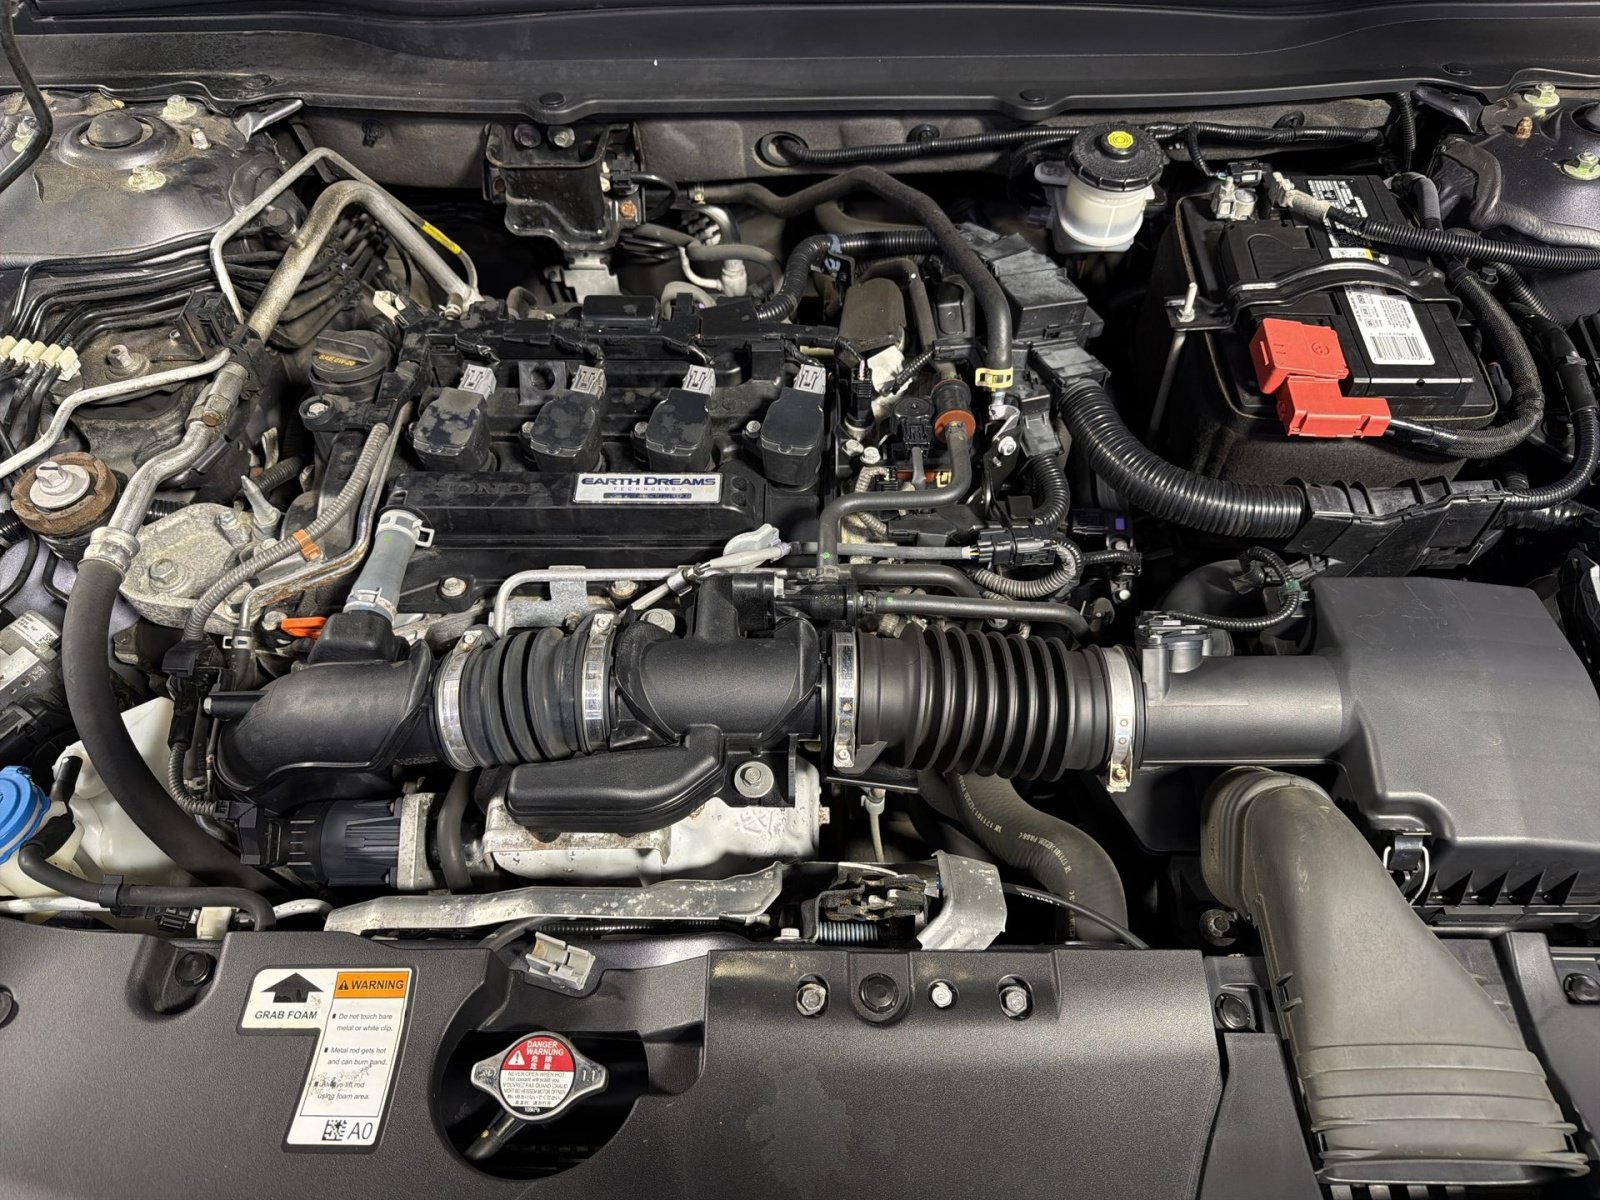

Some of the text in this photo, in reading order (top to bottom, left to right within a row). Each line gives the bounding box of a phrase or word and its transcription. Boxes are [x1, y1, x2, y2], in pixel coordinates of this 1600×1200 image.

[581, 476, 716, 486] EARTH DREAMS
[351, 979, 404, 990] WARNING
[254, 1010, 318, 1020] GRAB FOAM
[380, 1025, 393, 1033] clip.
[527, 1040, 558, 1049] DANGER
[526, 1048, 564, 1057] WARNUNG
[582, 1070, 596, 1082] 1.1
